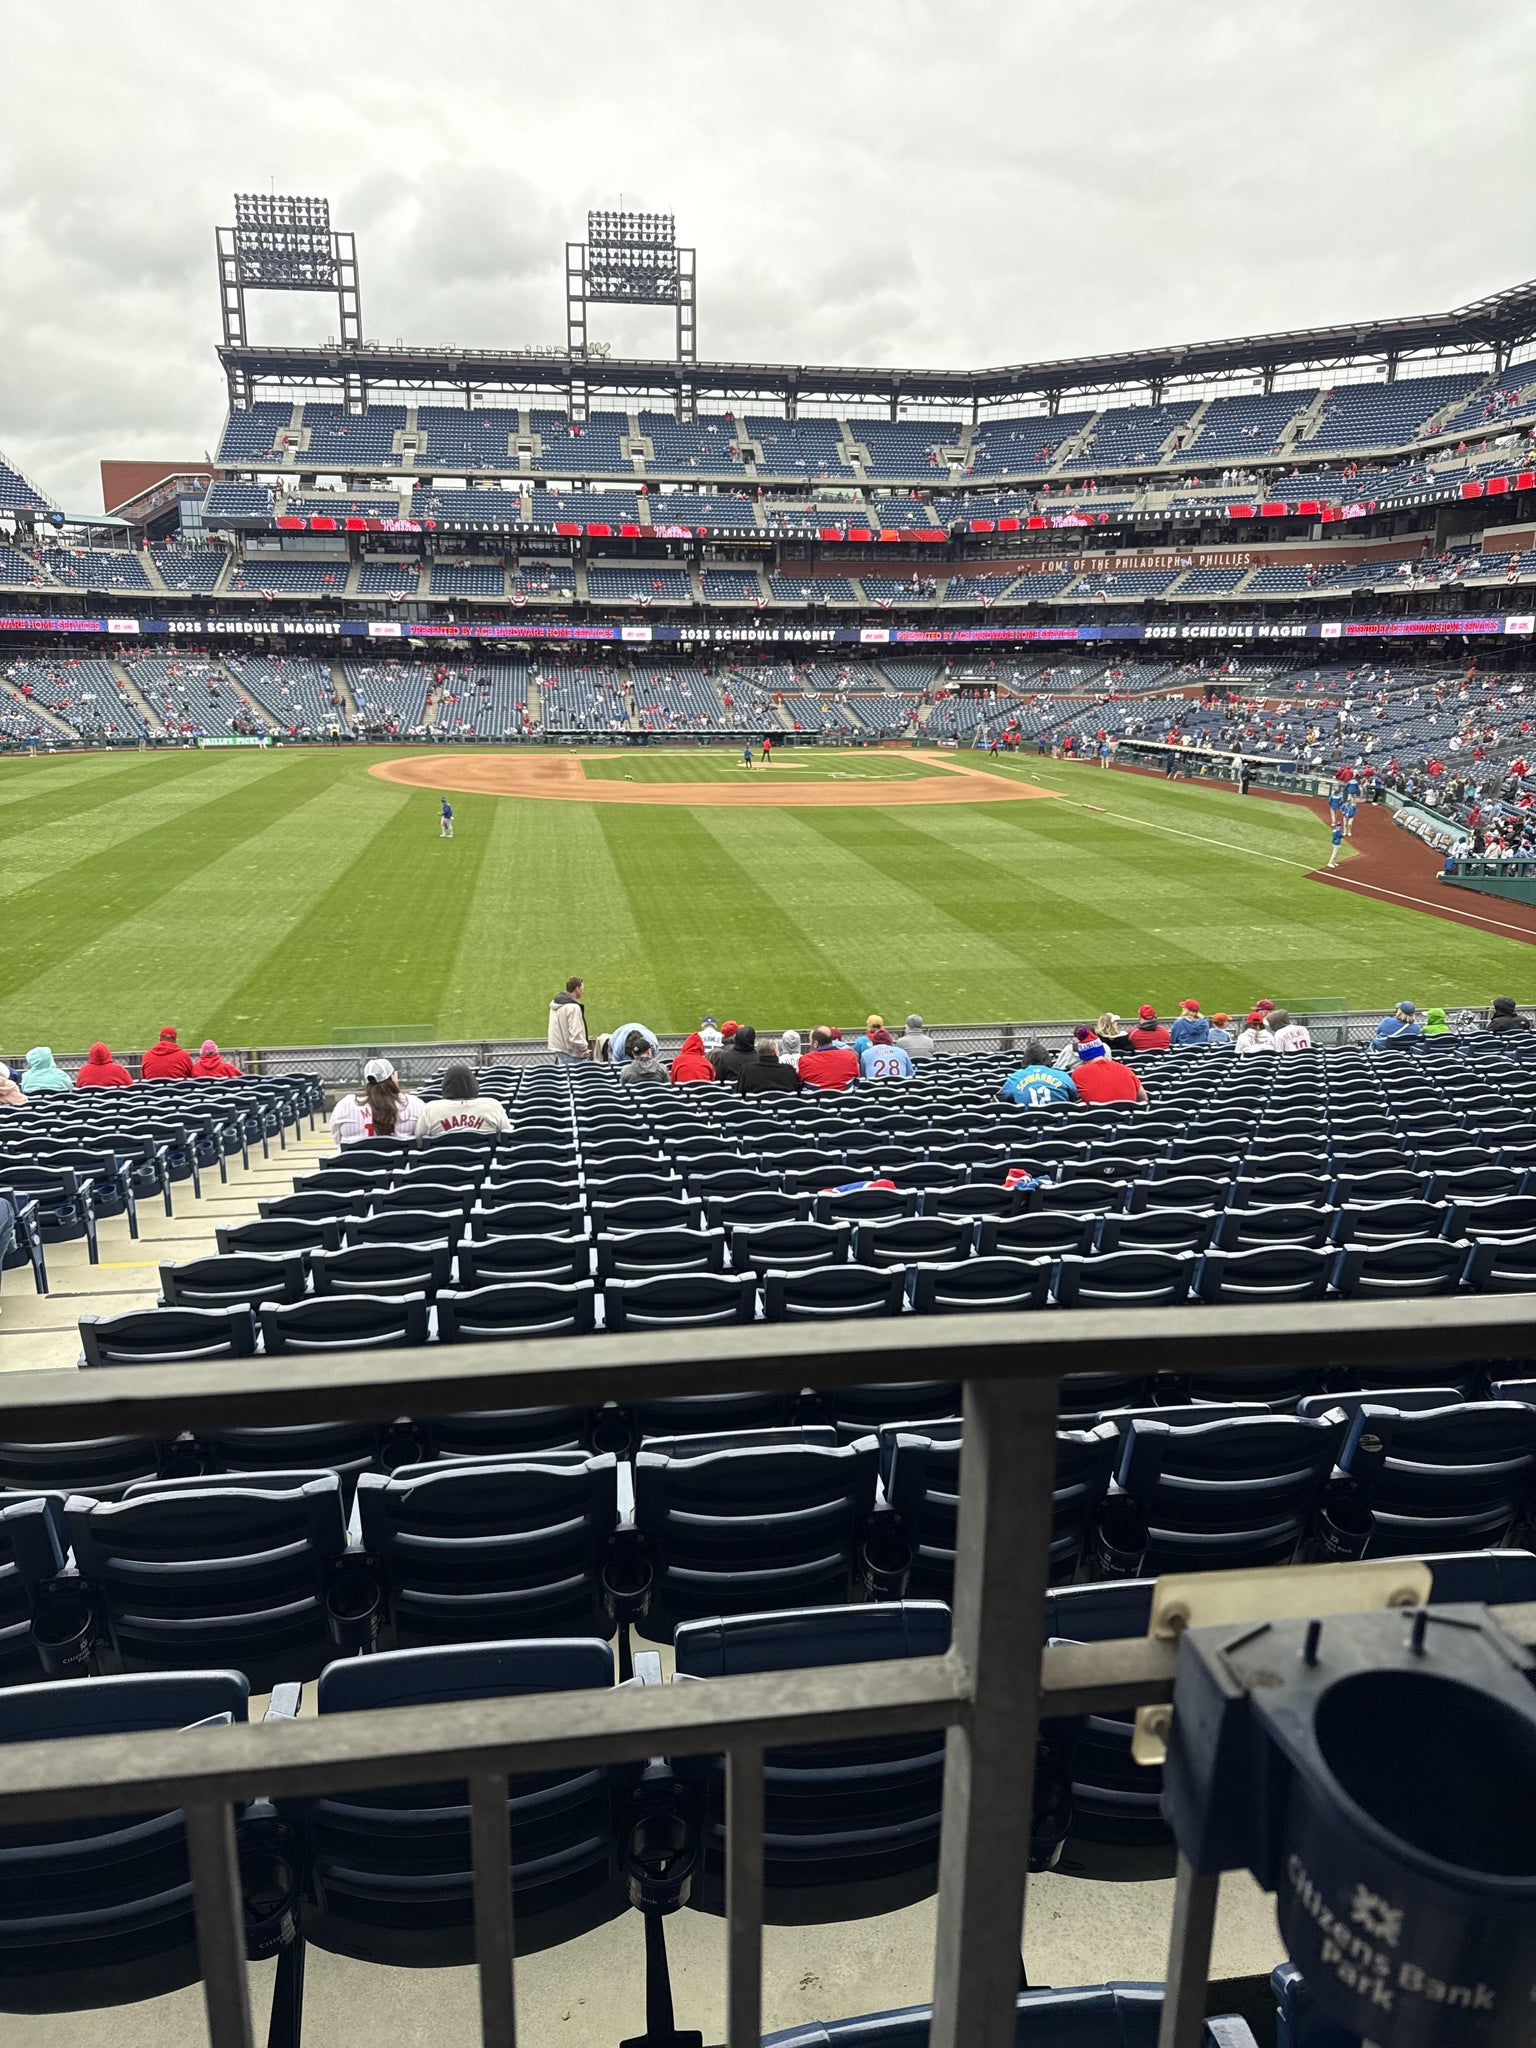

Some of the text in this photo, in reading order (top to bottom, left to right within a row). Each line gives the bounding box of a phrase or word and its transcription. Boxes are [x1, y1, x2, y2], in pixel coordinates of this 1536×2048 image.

[1073, 559, 1086, 571] OF
[1091, 558, 1109, 571] THE
[1115, 555, 1193, 570] PHILADELPHA
[1199, 553, 1251, 568] PHILLIES
[27, 620, 55, 630] HOME
[57, 621, 100, 631] SERVICES
[168, 622, 341, 635] 2025 SCHEDULE MAGNET
[409, 626, 614, 638] PRESENTED BY ACE HARDWARE HOME SERVICES
[1144, 626, 1177, 638] 2025
[1181, 625, 1253, 638] SCHEDULE
[1440, 620, 1461, 632] HOME
[680, 629, 836, 641] 2025 SCHEDULE MAGNET
[943, 632, 954, 640] BY
[1015, 630, 1038, 639] HOME
[873, 1059, 900, 1078] 28
[1016, 1072, 1063, 1093] SCHWARBER
[440, 1114, 485, 1132] MARSH
[1289, 1854, 1495, 2011] Citizens Bank
[1320, 1937, 1394, 2012] Park
